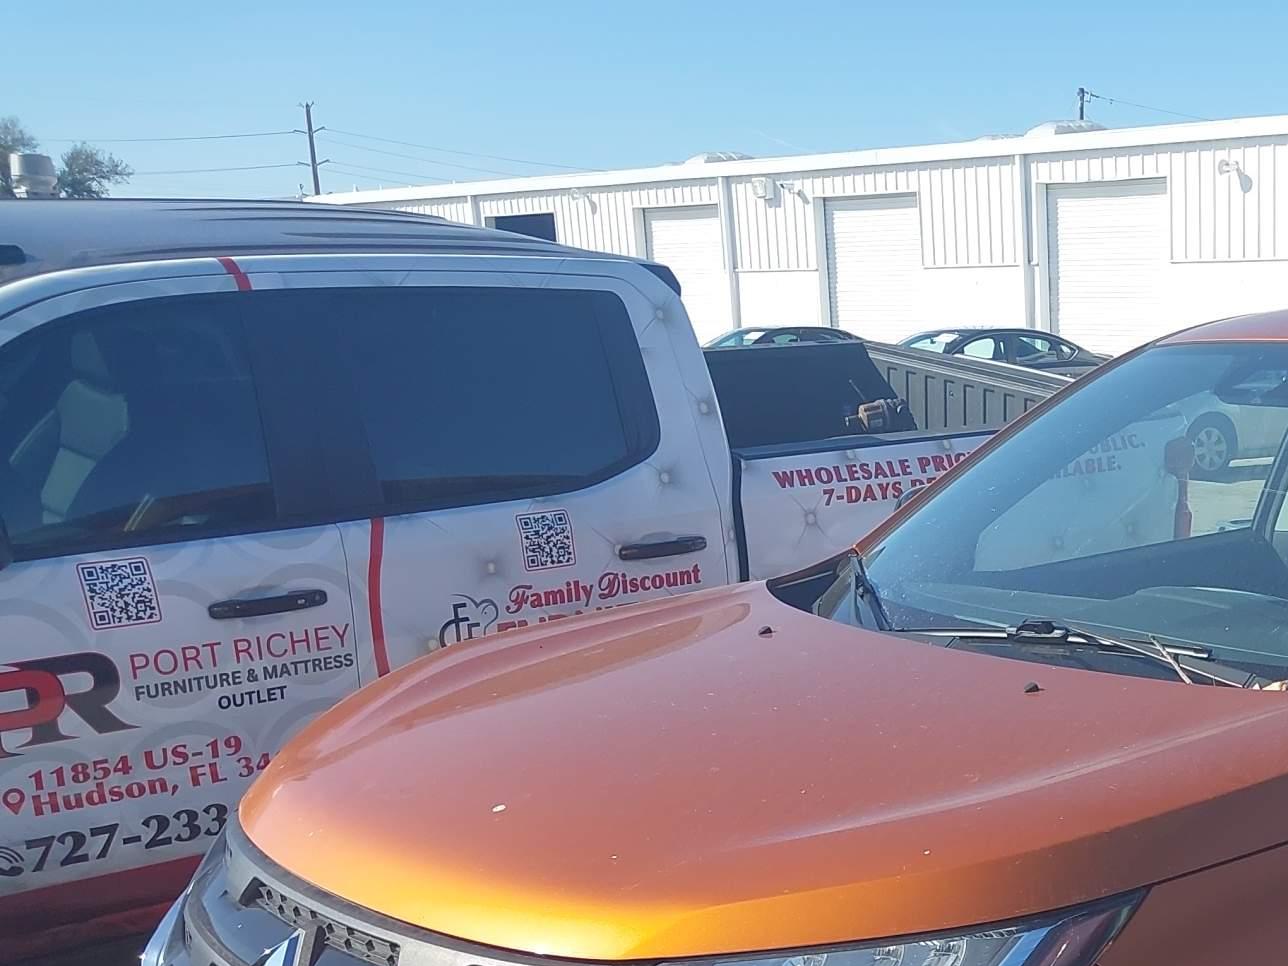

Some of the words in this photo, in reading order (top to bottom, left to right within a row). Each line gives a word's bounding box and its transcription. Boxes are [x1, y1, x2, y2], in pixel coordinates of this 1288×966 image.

[772, 458, 913, 489] WHOLESALE
[917, 452, 970, 474] PRIC
[822, 481, 904, 506] 7-DAYS
[505, 580, 594, 614] Family
[598, 563, 702, 599] Discount
[129, 641, 222, 681] PORT
[233, 623, 351, 665] RICHEY
[134, 670, 242, 701] FURNITURE
[246, 667, 259, 683] &
[262, 653, 354, 681] MATTRESS
[217, 685, 288, 710] OUTLET
[28, 755, 133, 791] 11854
[143, 735, 242, 770] US-19
[31, 774, 179, 817] Hudson,
[189, 761, 228, 787] FL
[236, 752, 280, 778] 34
[25, 803, 239, 873] 727-233
